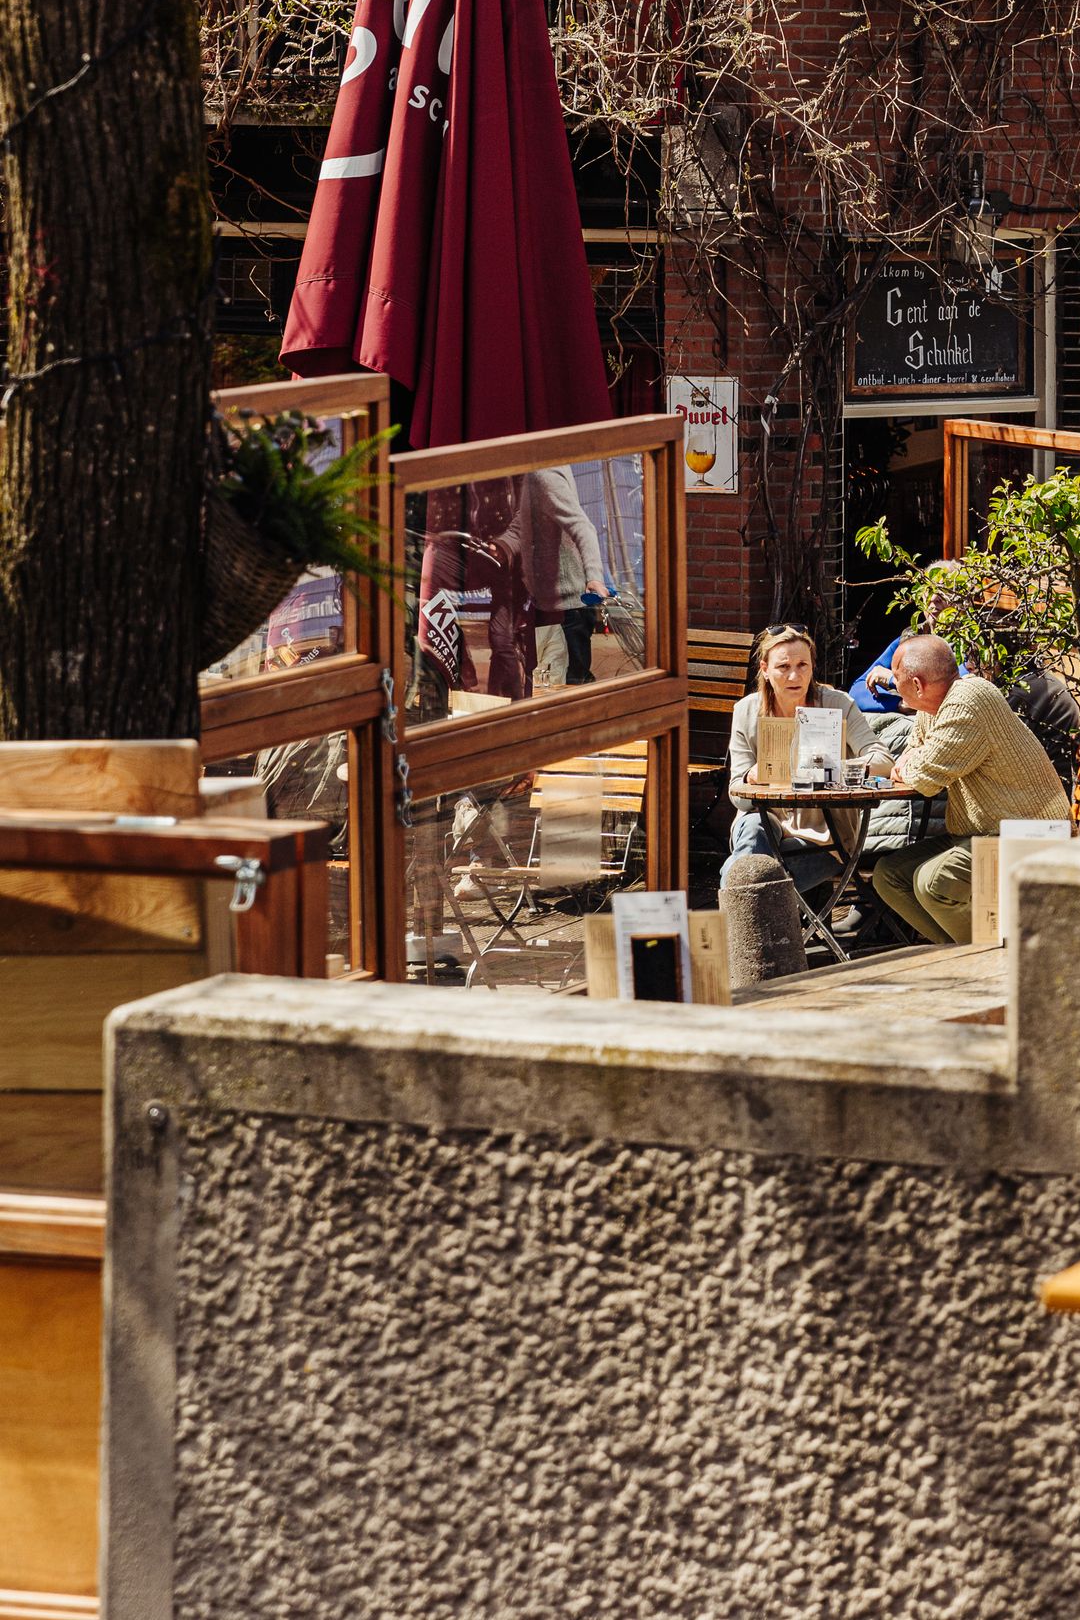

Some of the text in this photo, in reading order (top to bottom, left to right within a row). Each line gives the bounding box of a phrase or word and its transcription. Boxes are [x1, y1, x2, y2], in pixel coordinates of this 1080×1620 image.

[886, 287, 929, 326] Gent
[938, 304, 959, 321] aan
[904, 330, 974, 370] Schinkel
[946, 373, 968, 384] borrel
[675, 404, 728, 425] Duvel
[427, 630, 450, 656] SAYS
